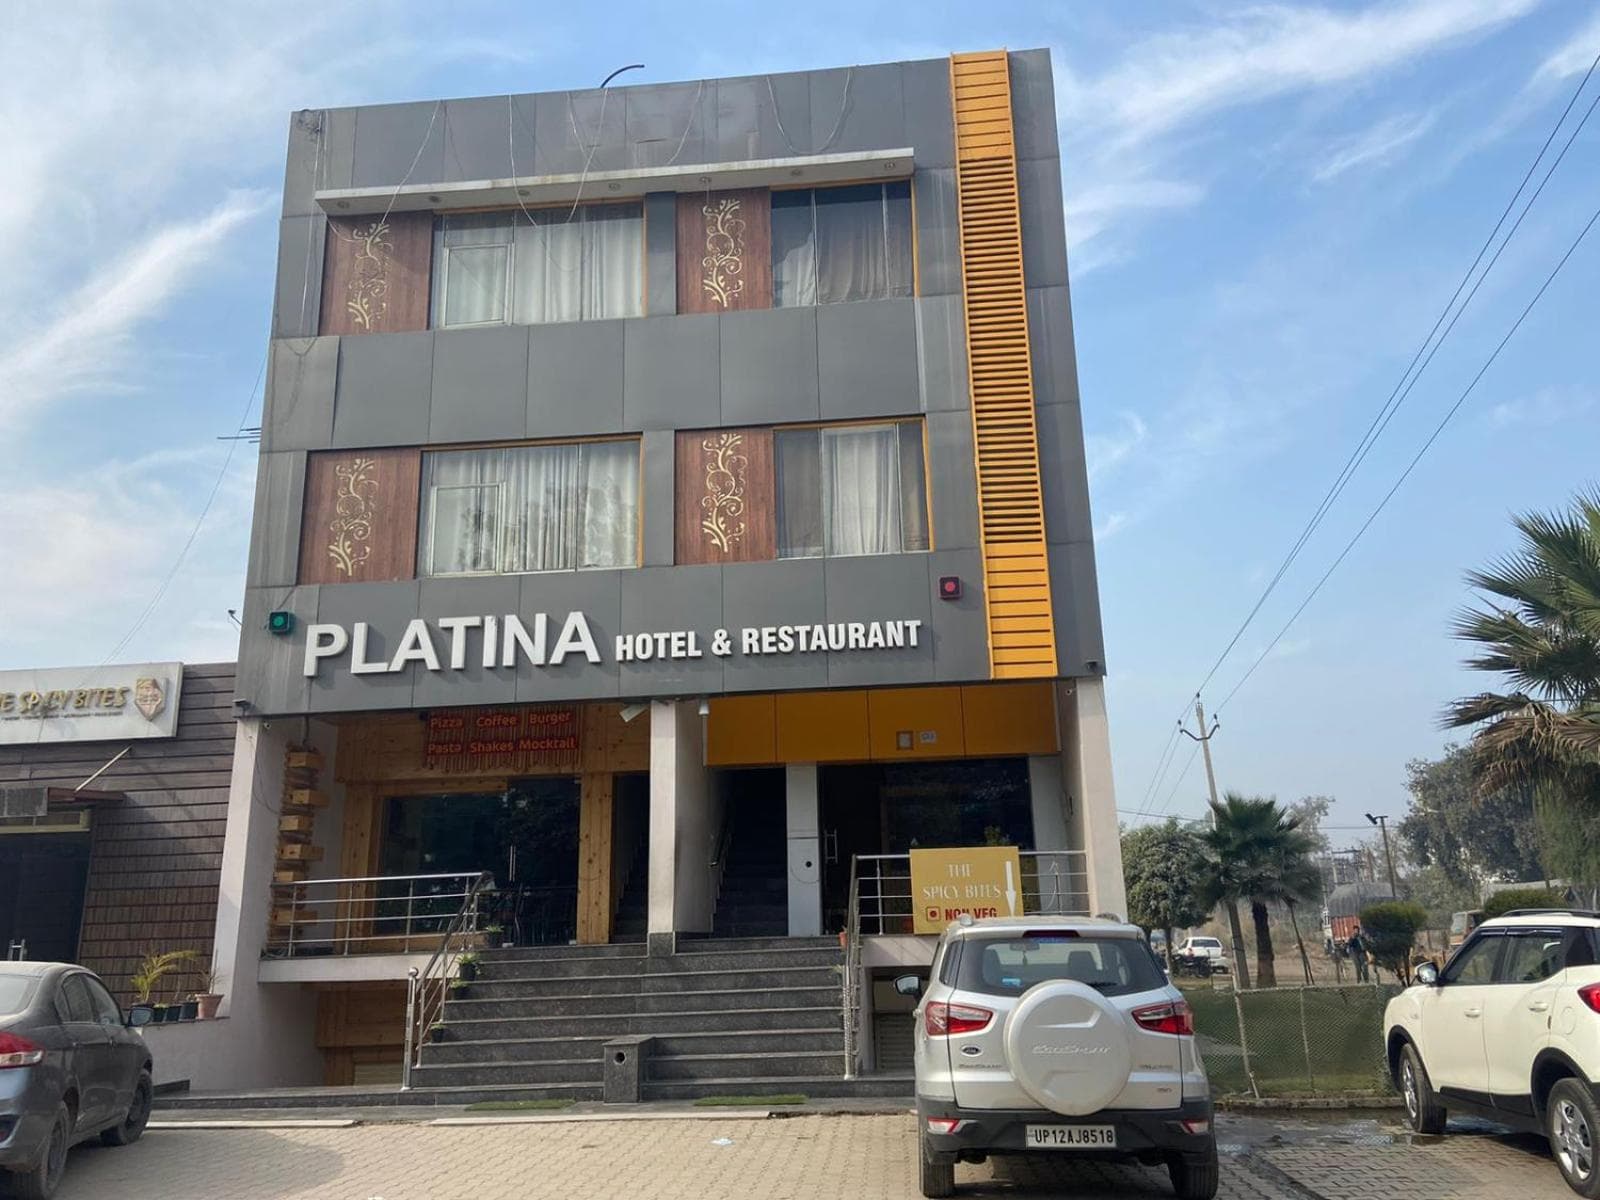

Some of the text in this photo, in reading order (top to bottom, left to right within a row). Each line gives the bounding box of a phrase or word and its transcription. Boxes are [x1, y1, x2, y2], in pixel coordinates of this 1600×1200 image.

[303, 611, 921, 677] PLATINA HOTEL & RESTAURANT
[73, 687, 130, 709] BITES
[430, 712, 571, 729] Pizza Coffee Burger
[428, 742, 462, 754] Pasta
[470, 741, 514, 753] Shakes
[922, 884, 1000, 900] SPICY BITES
[974, 907, 997, 919] VEG
[1034, 1130, 1114, 1144] UP12AJ8518
